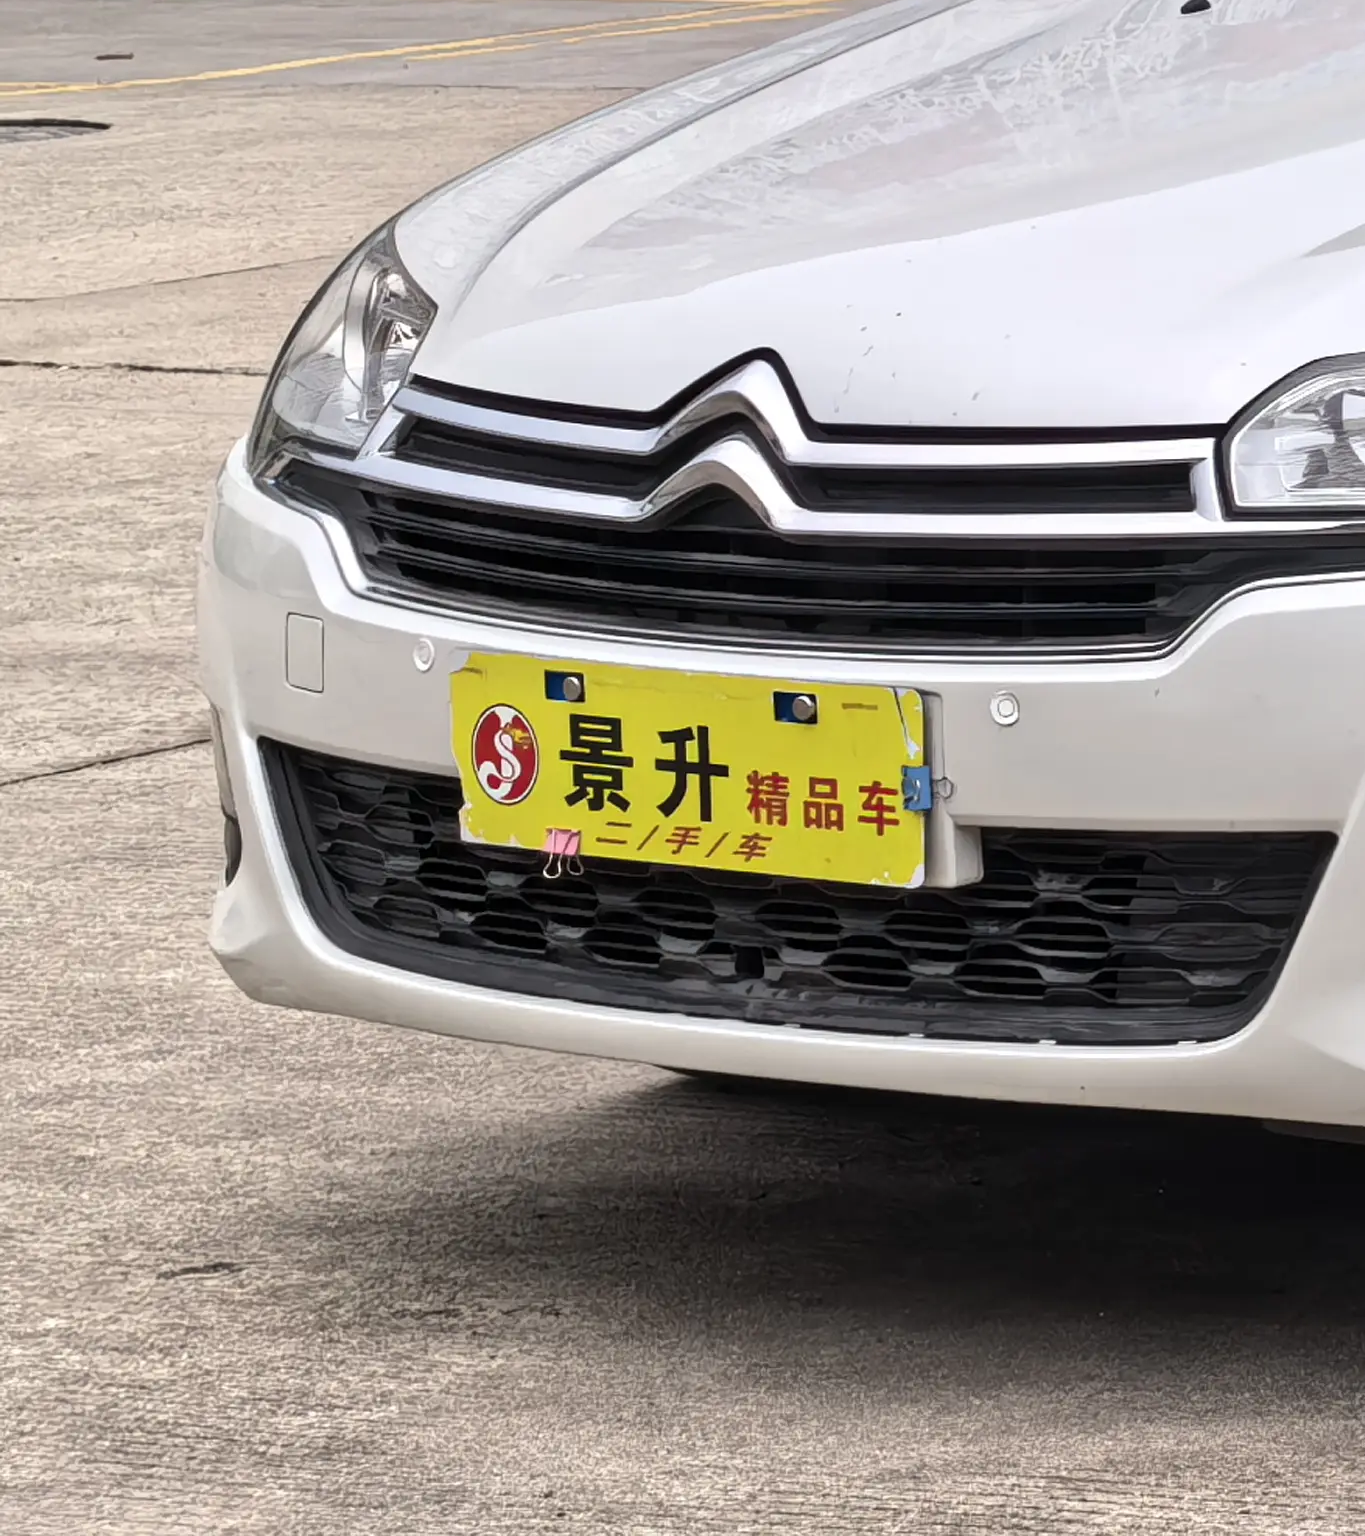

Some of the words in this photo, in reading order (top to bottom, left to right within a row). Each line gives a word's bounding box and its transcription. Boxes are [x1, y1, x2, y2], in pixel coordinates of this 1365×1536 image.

[559, 713, 730, 823] 景升
[745, 769, 901, 835] 精品车
